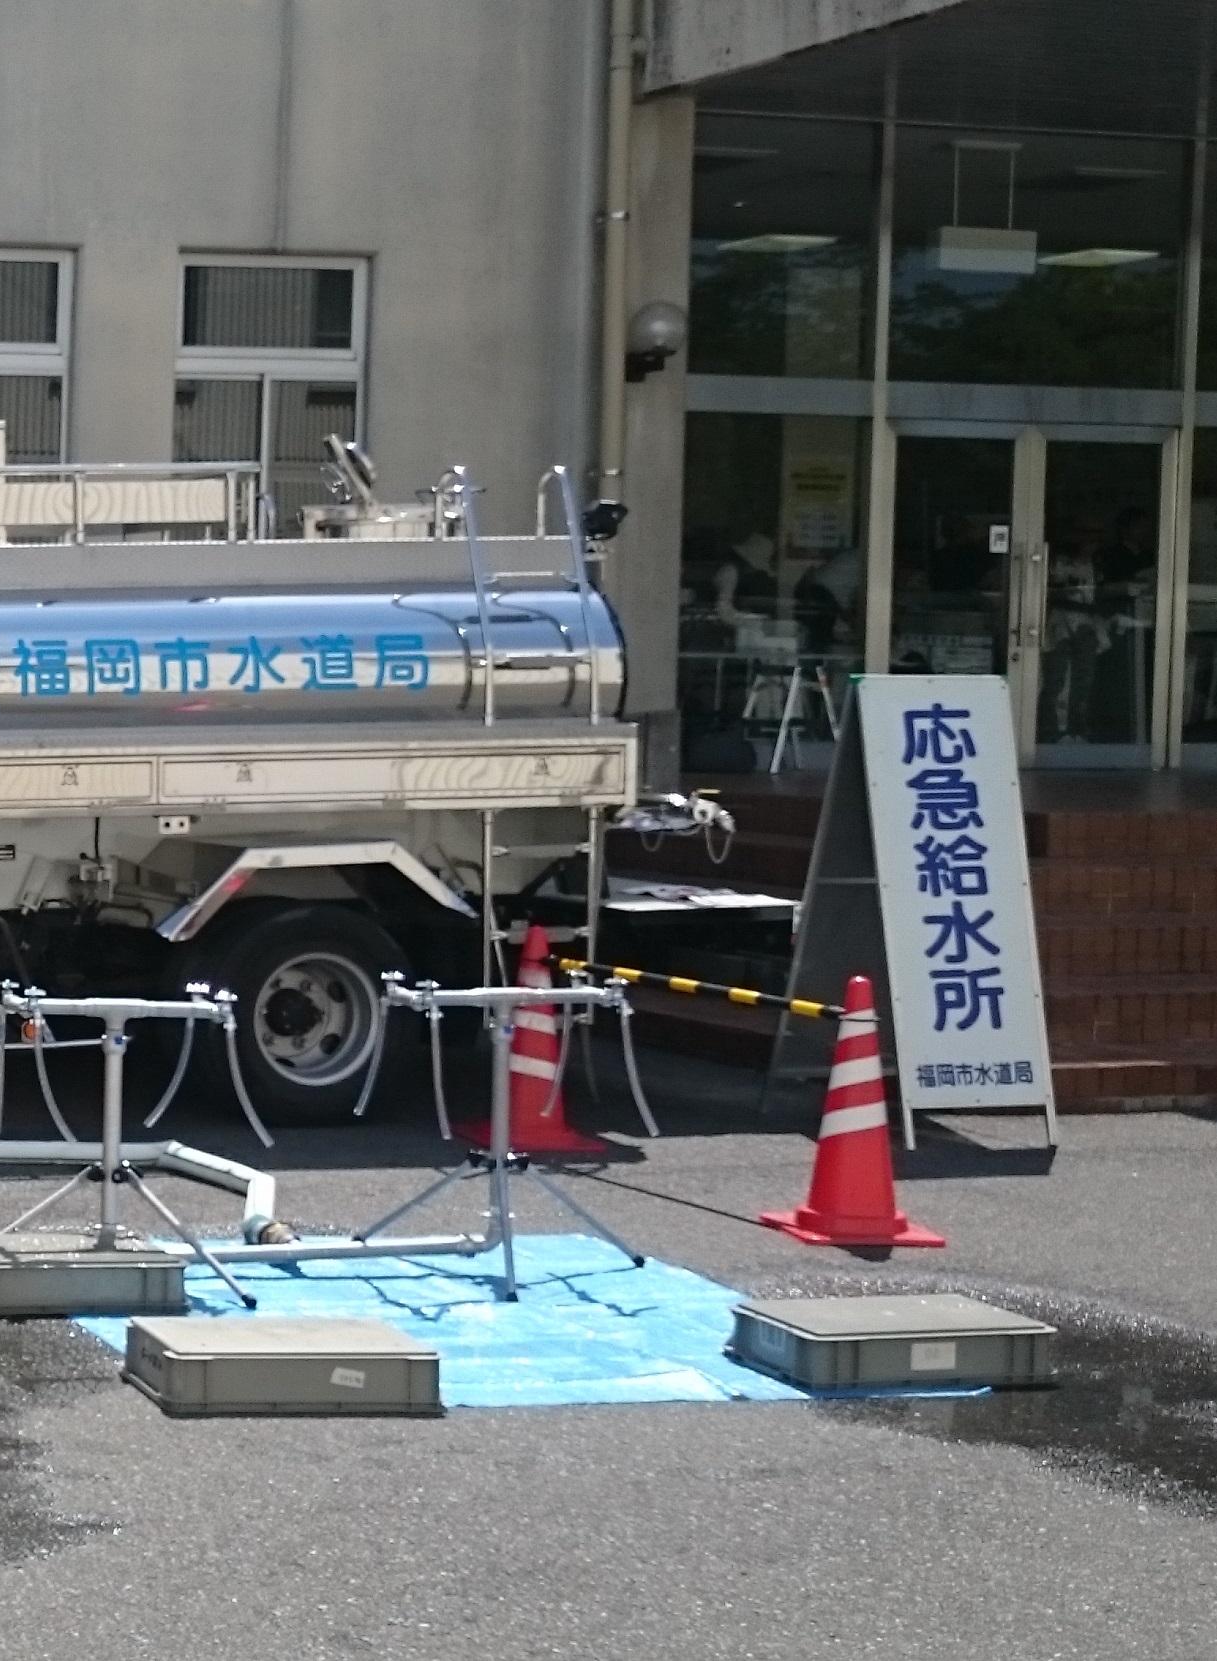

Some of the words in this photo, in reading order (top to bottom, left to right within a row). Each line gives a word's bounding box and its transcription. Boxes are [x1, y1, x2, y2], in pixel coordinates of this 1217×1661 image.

[13, 634, 429, 696] 福岡市水道局
[902, 703, 1006, 1032] 応急給水所
[916, 1061, 1034, 1088] 福岡市水道局
